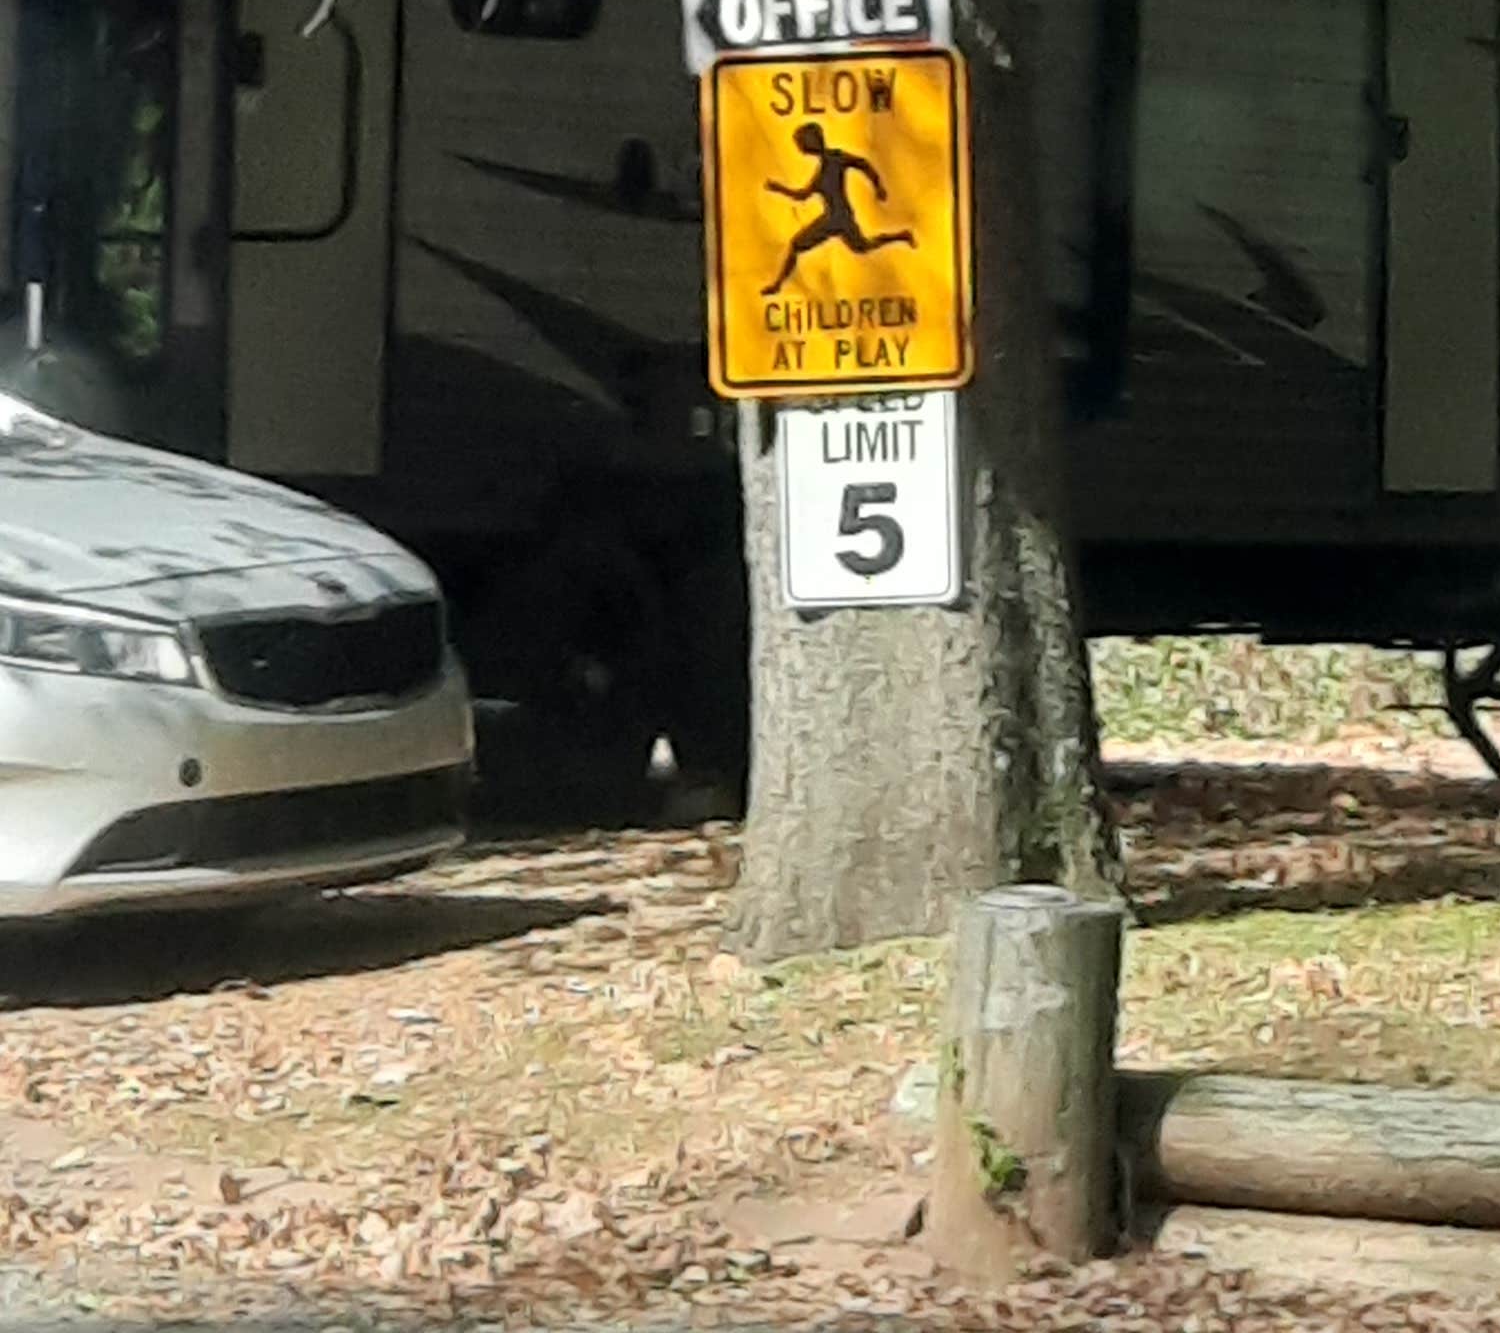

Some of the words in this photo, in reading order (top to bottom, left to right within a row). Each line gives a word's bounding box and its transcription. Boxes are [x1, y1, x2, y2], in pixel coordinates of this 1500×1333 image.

[769, 66, 897, 116] SLOW
[763, 295, 918, 333] CHILDREN
[772, 339, 806, 371] AT
[833, 334, 910, 370] PLAY
[822, 418, 925, 464] LIMIT
[834, 481, 906, 577] 5
